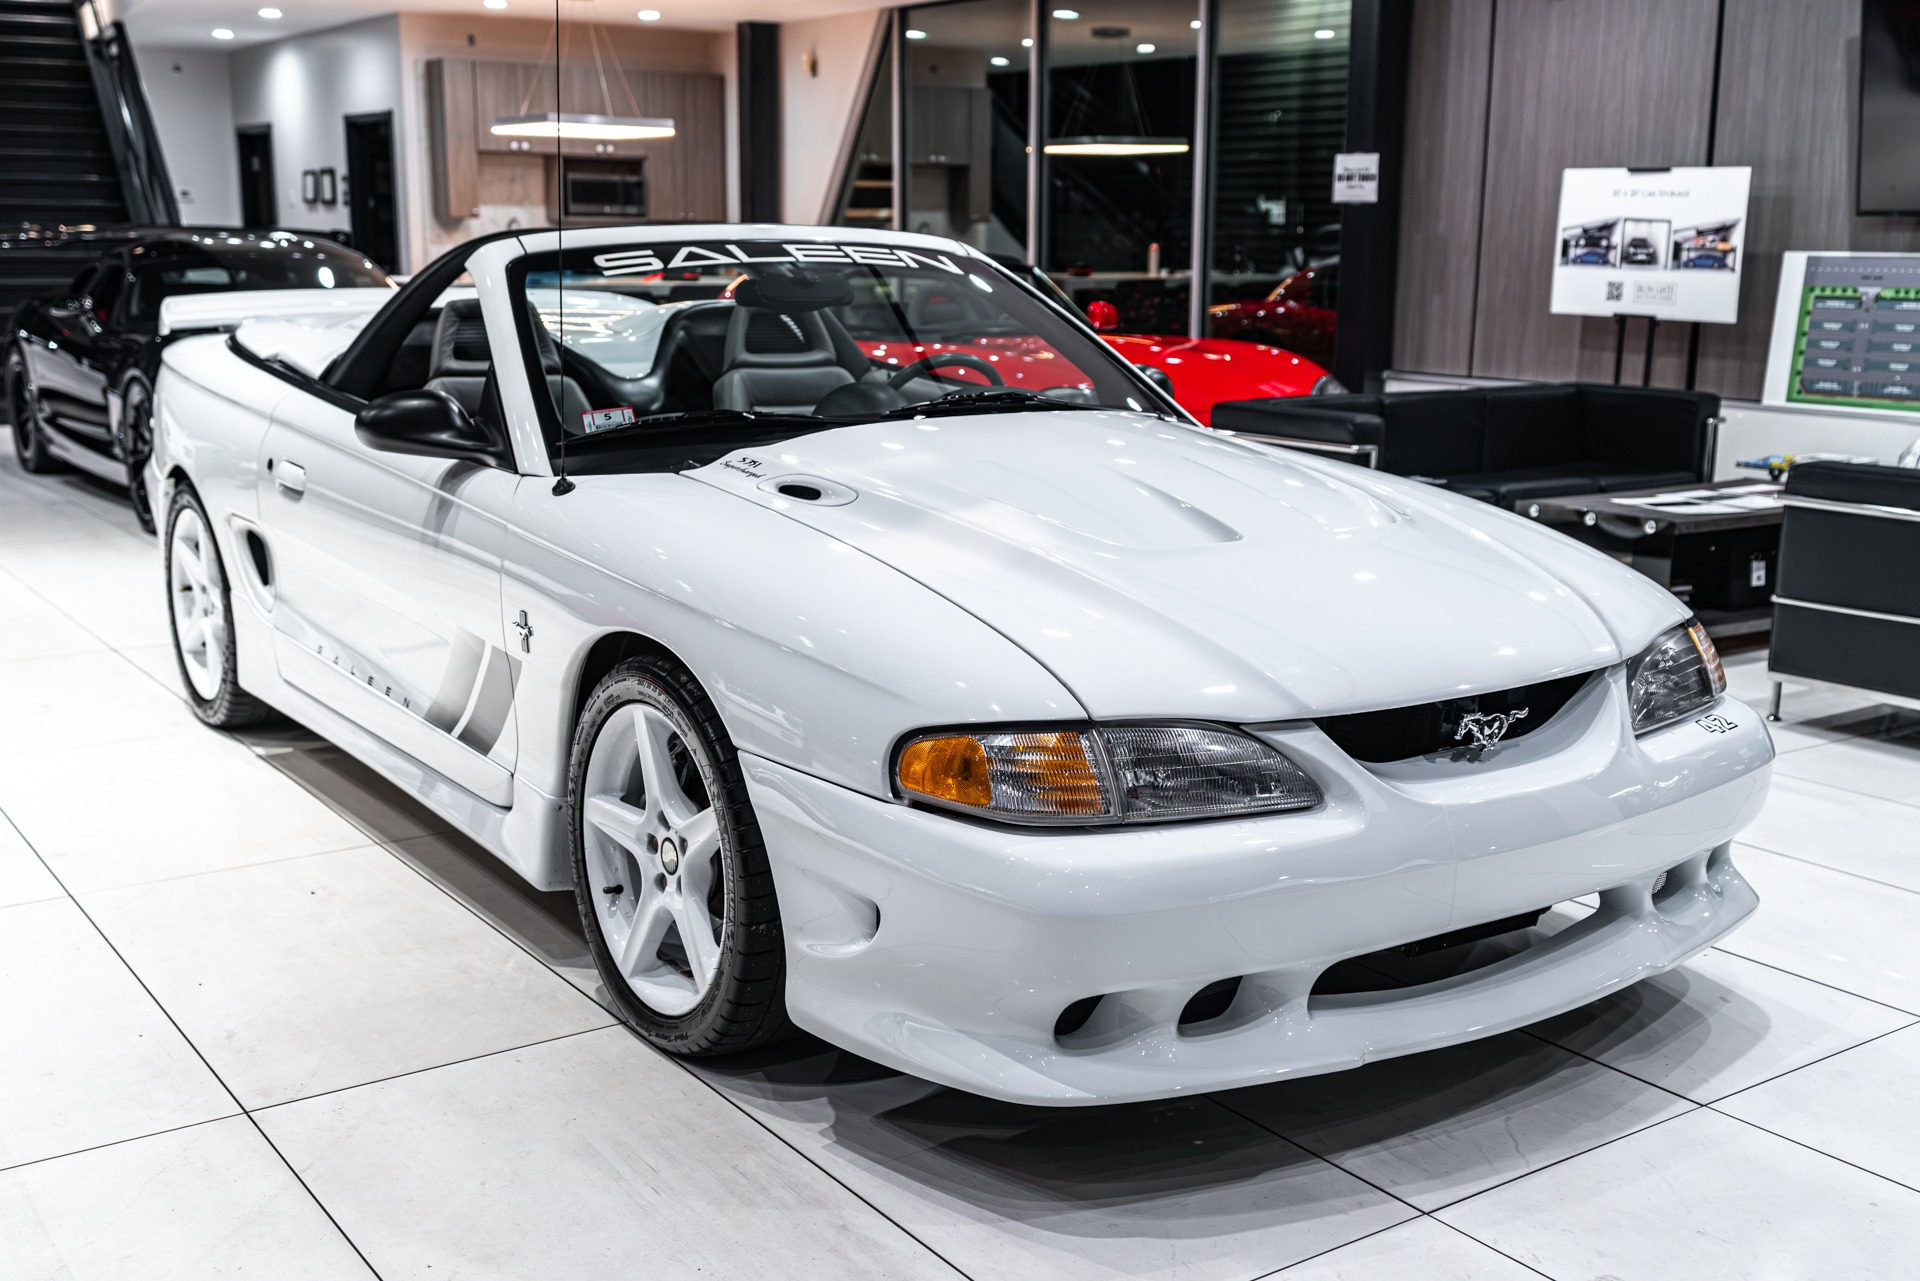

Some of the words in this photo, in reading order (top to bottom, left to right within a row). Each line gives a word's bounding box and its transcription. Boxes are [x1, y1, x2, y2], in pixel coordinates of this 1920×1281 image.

[594, 244, 964, 277] SALEEN
[604, 412, 612, 421] 5
[317, 645, 410, 709] SALEEN
[1695, 714, 1738, 734] 42
[723, 833, 735, 923] MICHELIN
